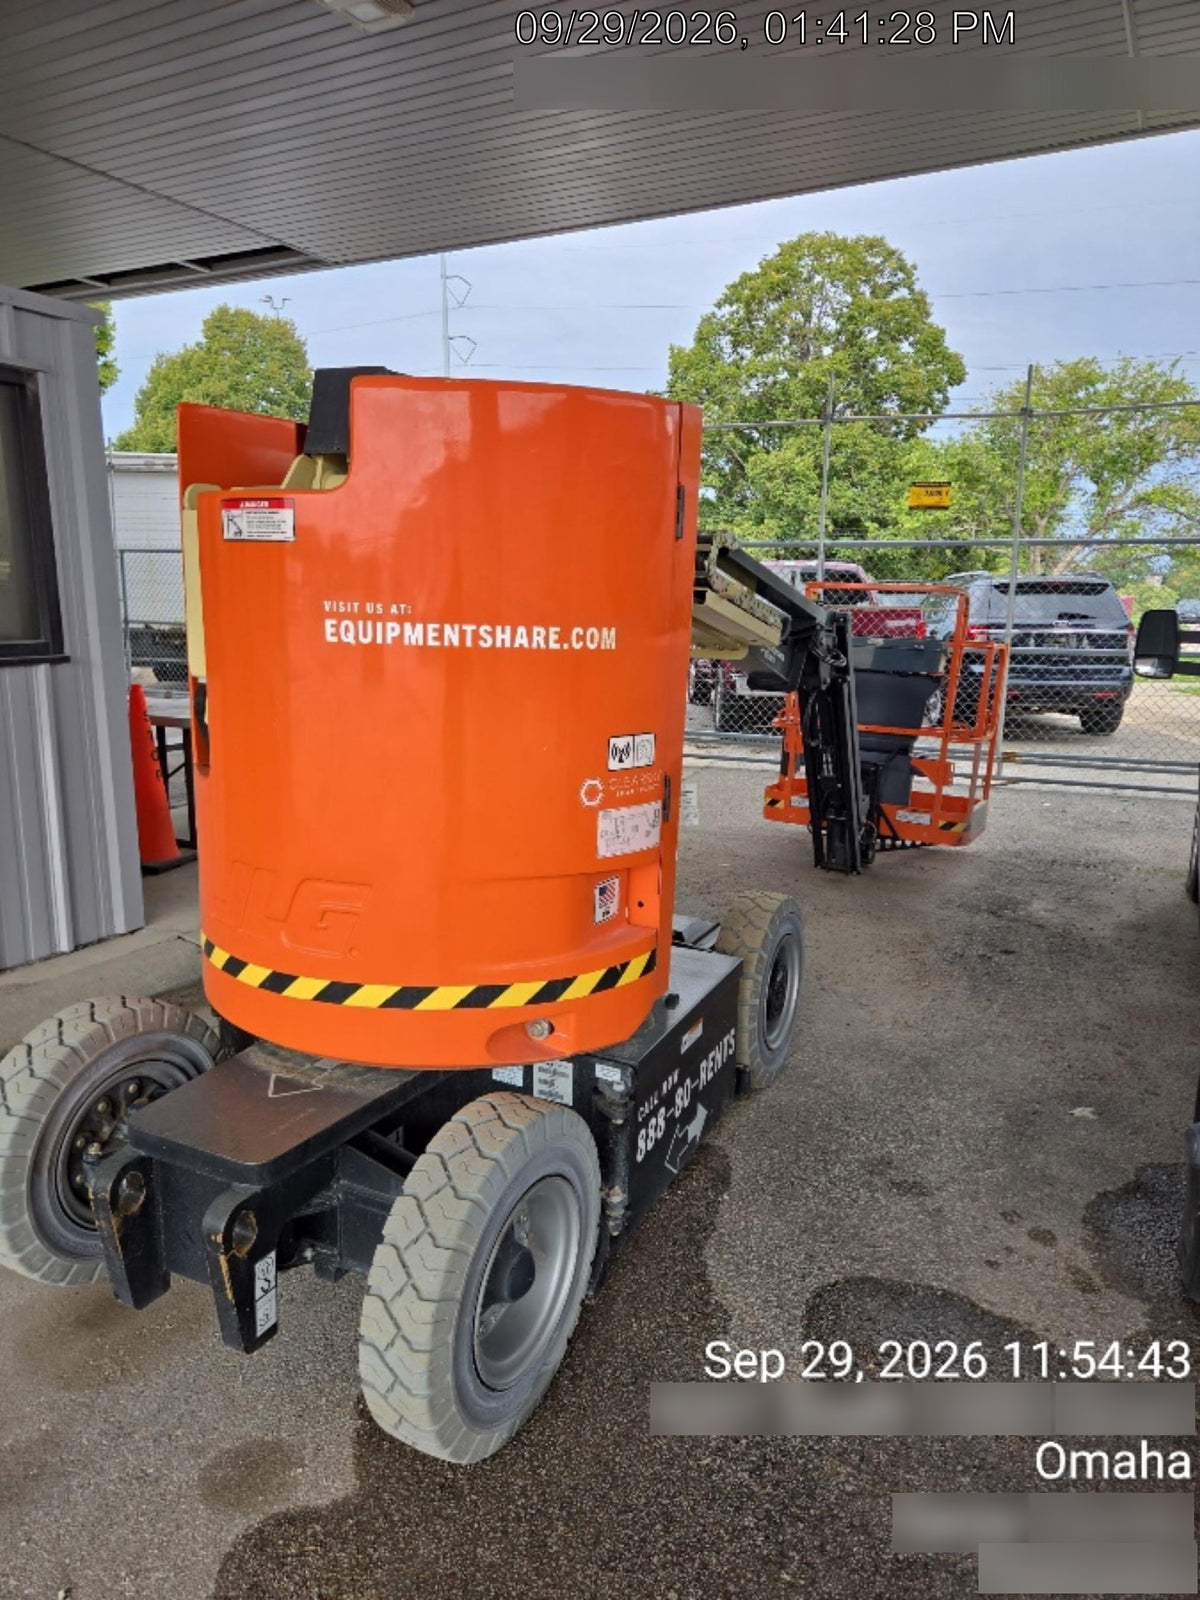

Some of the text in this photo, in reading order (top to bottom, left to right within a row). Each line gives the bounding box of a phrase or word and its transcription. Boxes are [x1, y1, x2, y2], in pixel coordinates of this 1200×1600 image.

[323, 600, 413, 616] VISIT US AT:
[324, 618, 617, 651] EQUIPMENTSHARE.COM
[635, 1027, 736, 1163] 888-80-RENTS
